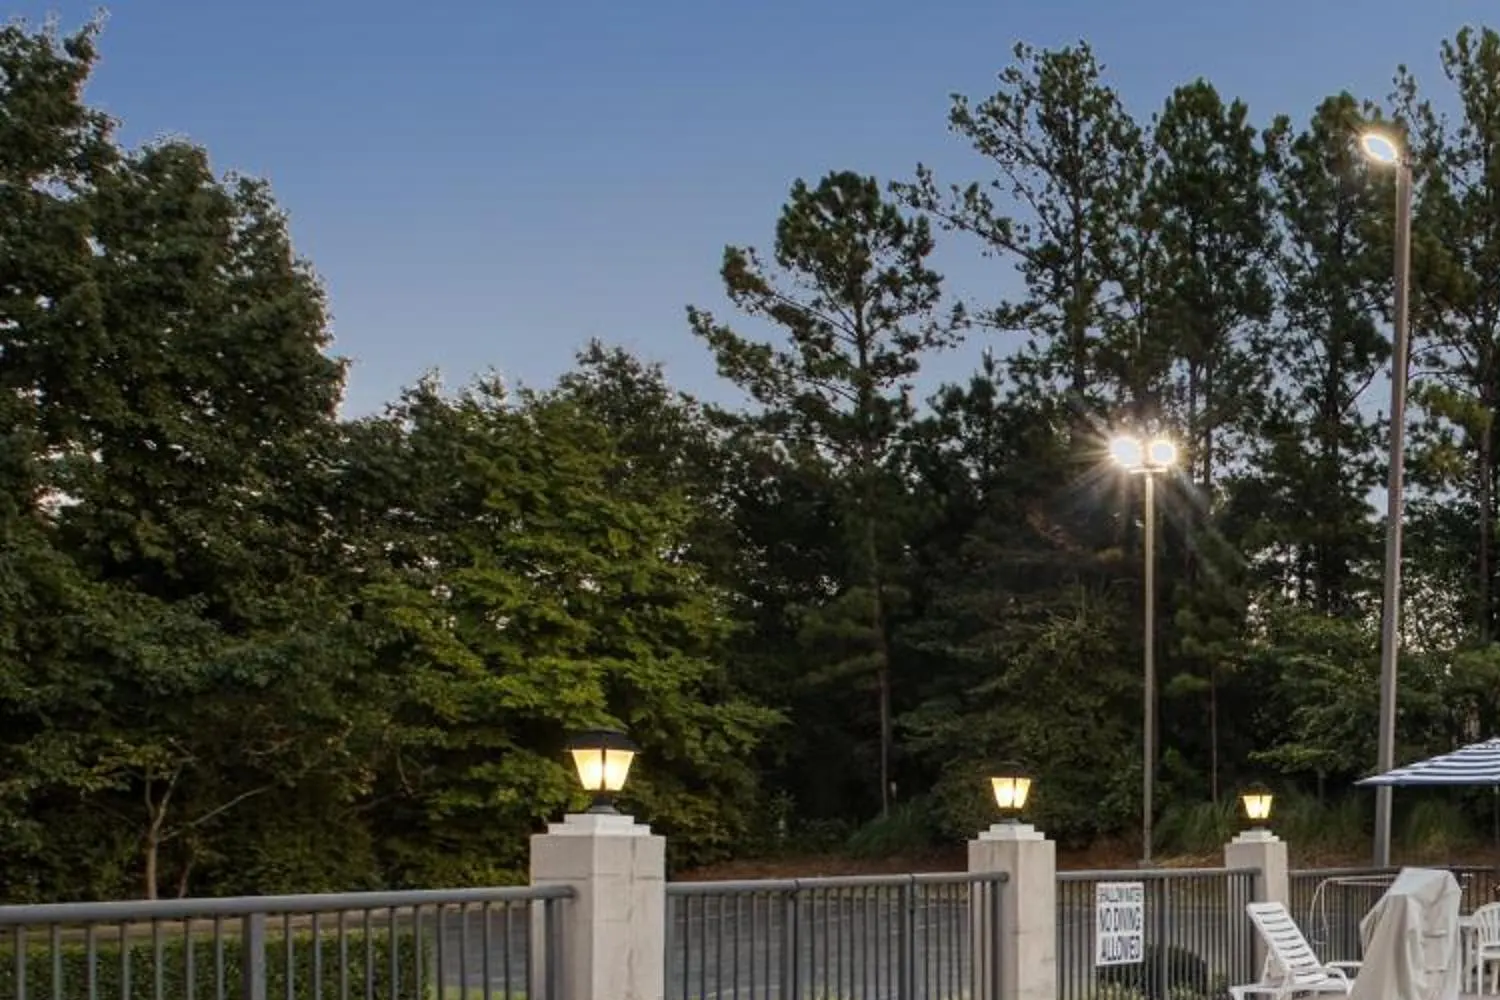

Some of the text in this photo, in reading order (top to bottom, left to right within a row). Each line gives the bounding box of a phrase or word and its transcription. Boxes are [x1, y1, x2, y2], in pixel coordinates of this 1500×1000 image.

[1100, 905, 1140, 931] NO DIVING
[1101, 935, 1140, 961] ALLOWED
